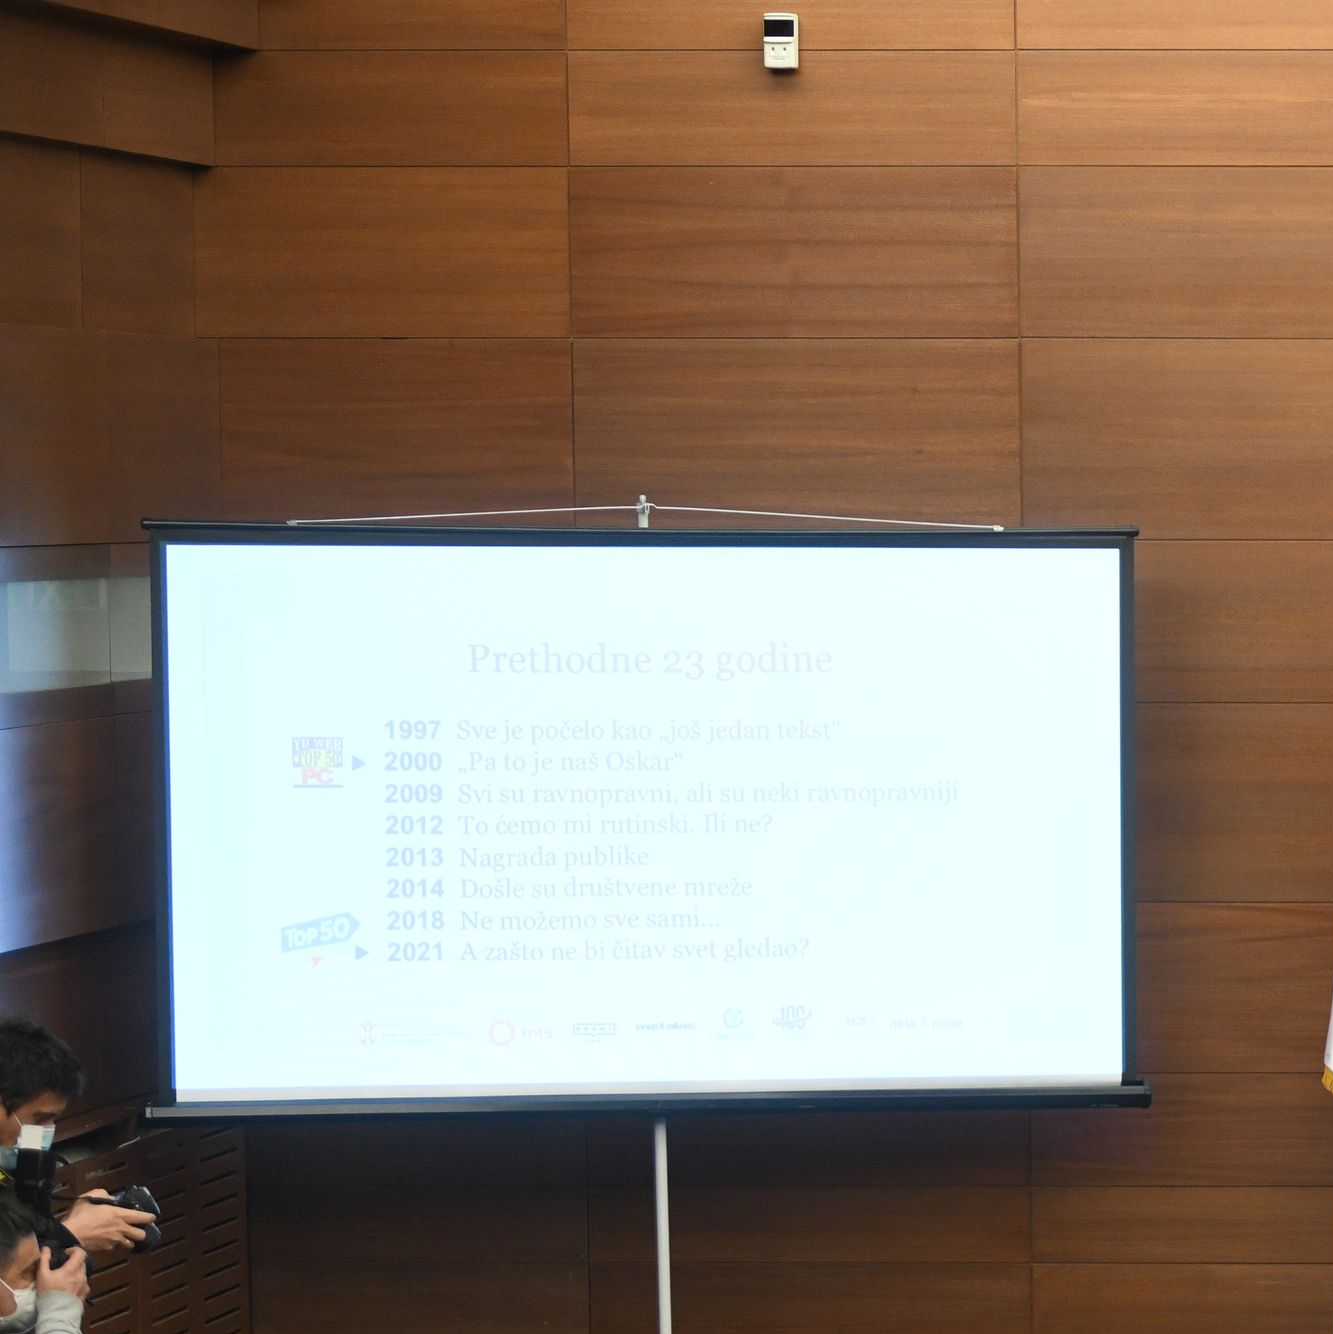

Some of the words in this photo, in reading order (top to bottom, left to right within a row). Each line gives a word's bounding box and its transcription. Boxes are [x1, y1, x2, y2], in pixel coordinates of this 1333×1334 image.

[466, 641, 652, 675] Prethodne
[663, 650, 705, 681] 23
[715, 641, 833, 682] godine
[384, 719, 442, 741] 1997
[457, 719, 497, 741] Sve
[501, 719, 524, 746] je
[530, 718, 605, 746] počelo
[611, 718, 653, 741] kao
[706, 718, 771, 746] jedan
[384, 750, 443, 773] 2000
[503, 752, 527, 773] to
[531, 750, 553, 777] je
[559, 750, 601, 773] naš
[384, 782, 443, 805] 2009
[458, 782, 493, 805] Svi
[498, 787, 526, 805] su
[532, 782, 679, 809] ravnopravni,
[685, 780, 713, 803] ali
[719, 787, 745, 804] su
[752, 780, 801, 803] neki
[808, 779, 959, 808] ravnopravniji
[384, 813, 445, 836] 2012
[457, 814, 489, 837] To
[495, 813, 557, 836] ćemo
[563, 813, 593, 835] mi
[600, 812, 696, 835] rutinski.
[703, 812, 728, 834] Ili
[735, 813, 773, 834] ne?
[384, 845, 445, 868] 2013
[458, 845, 557, 873] Nagrada
[563, 844, 649, 872] publike
[384, 876, 445, 900] 2014
[459, 872, 526, 899] Došle
[531, 882, 557, 898] su
[563, 872, 677, 898] društvene
[683, 875, 753, 897] mreže
[385, 907, 445, 932] 2018
[459, 910, 497, 931] Ne
[500, 909, 597, 931] možemo
[603, 911, 641, 930] sve
[386, 940, 445, 963] 2021
[460, 941, 480, 962] A
[485, 940, 544, 962] zašto
[551, 945, 578, 962] ne
[583, 938, 606, 961] bi
[611, 938, 667, 961] čitav
[672, 940, 718, 960] svet
[724, 936, 811, 965] gledao?
